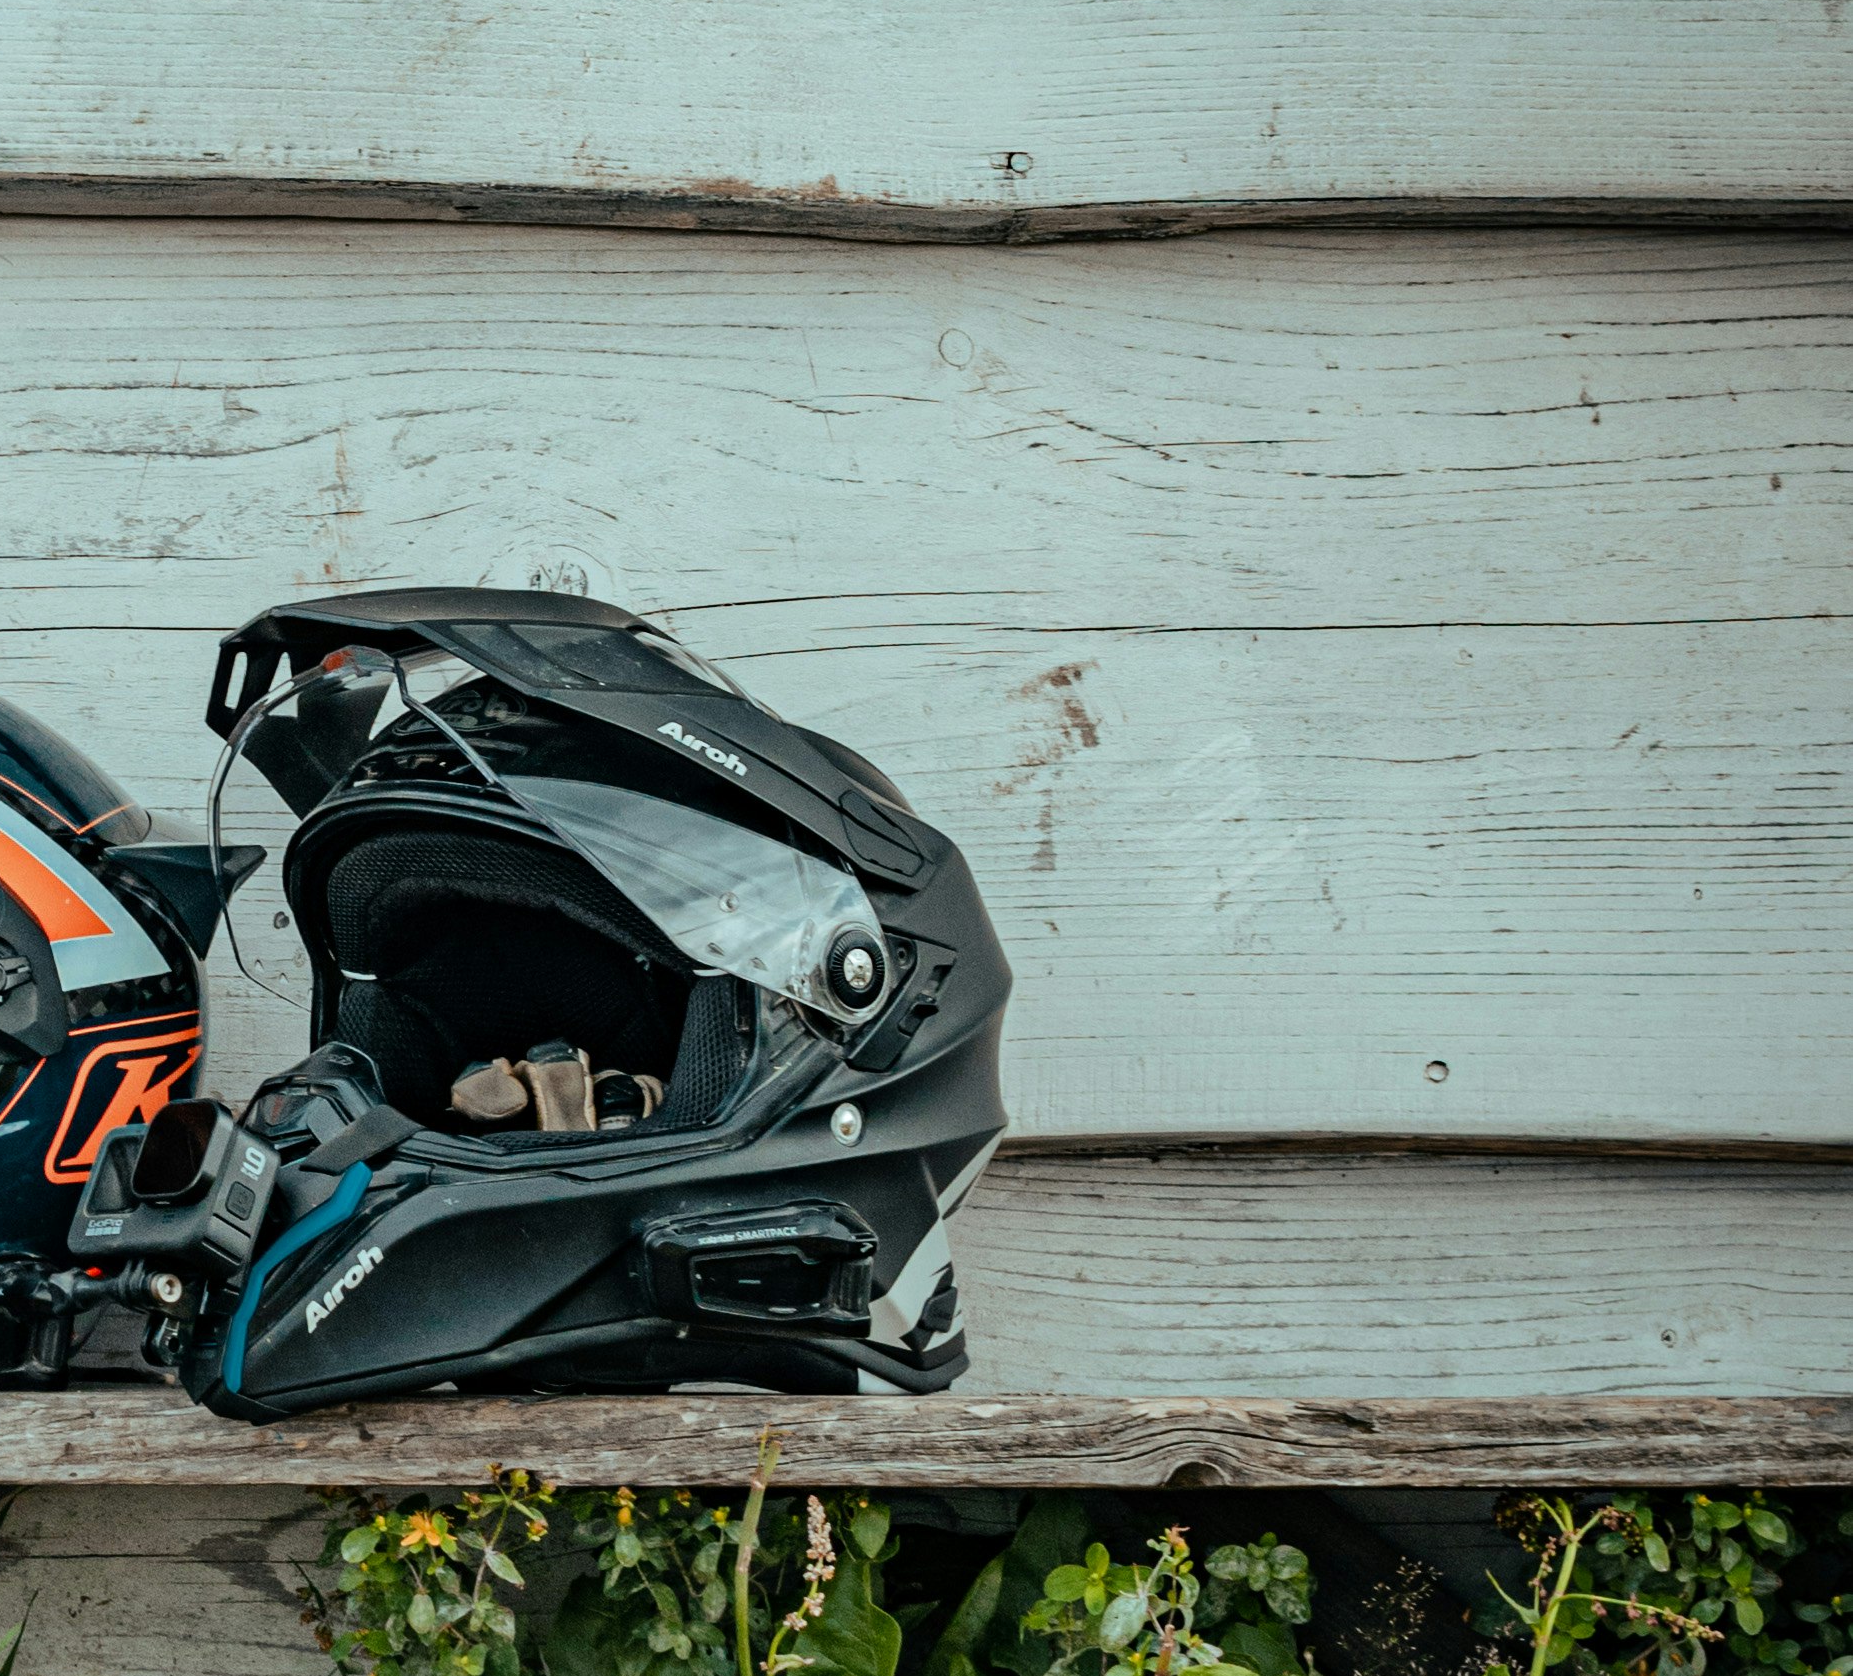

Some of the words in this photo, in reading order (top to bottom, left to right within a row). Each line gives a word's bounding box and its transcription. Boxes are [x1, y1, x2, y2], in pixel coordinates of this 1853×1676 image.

[657, 722, 747, 777] Airoh
[735, 1226, 798, 1240] SMARTPACK
[306, 1246, 384, 1334] Airoh
